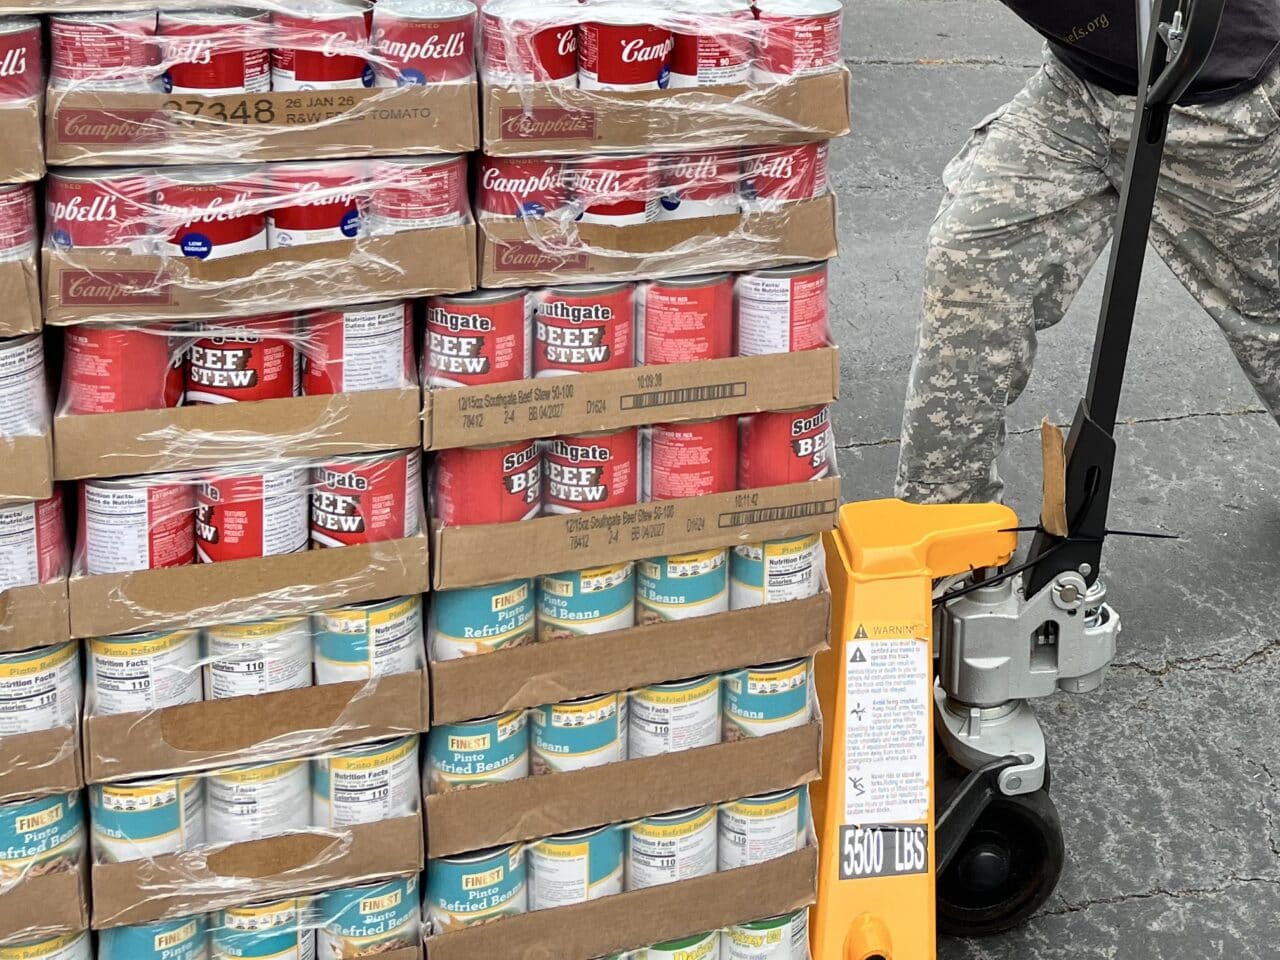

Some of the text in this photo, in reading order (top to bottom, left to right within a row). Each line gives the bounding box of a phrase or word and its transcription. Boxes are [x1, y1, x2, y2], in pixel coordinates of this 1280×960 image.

[307, 97, 333, 108] JAN
[371, 108, 431, 120] TOMATO
[537, 323, 598, 346] BEEF
[547, 346, 608, 363] STEW
[191, 368, 255, 387] STEW
[518, 388, 533, 404] Beef
[535, 388, 550, 401] Stew
[550, 481, 605, 501] STEW
[769, 555, 798, 566] Nutrition
[768, 577, 793, 586] Calories
[494, 587, 527, 609] FINEST
[650, 590, 686, 604] Beans
[498, 605, 524, 621] Pinto
[559, 608, 600, 620] Beans
[375, 621, 401, 634] Nutrition
[464, 617, 515, 639] Refried
[126, 659, 148, 667] Facts
[245, 661, 264, 671] 110
[34, 672, 56, 685] Facts
[131, 679, 150, 690] 110
[40, 692, 57, 705] 110
[732, 706, 764, 719] Beans
[654, 726, 669, 734] 110
[451, 736, 487, 750] FINEST
[537, 740, 569, 753] Beans
[454, 753, 484, 763] Pinto
[476, 754, 515, 773] Beans
[335, 770, 388, 781] Nutrition Facts
[335, 789, 388, 802] Calories 110
[20, 806, 61, 830] FINEST
[24, 825, 58, 843] Pinto
[733, 835, 746, 844] 110
[844, 826, 925, 876] 5500 LBS
[660, 858, 675, 867] 110
[465, 870, 501, 889] FINEST
[469, 886, 499, 900] Pinto
[363, 894, 400, 912] FINEST
[440, 895, 488, 912] Refried
[363, 909, 396, 924] Pinto
[158, 925, 195, 948] FINEST
